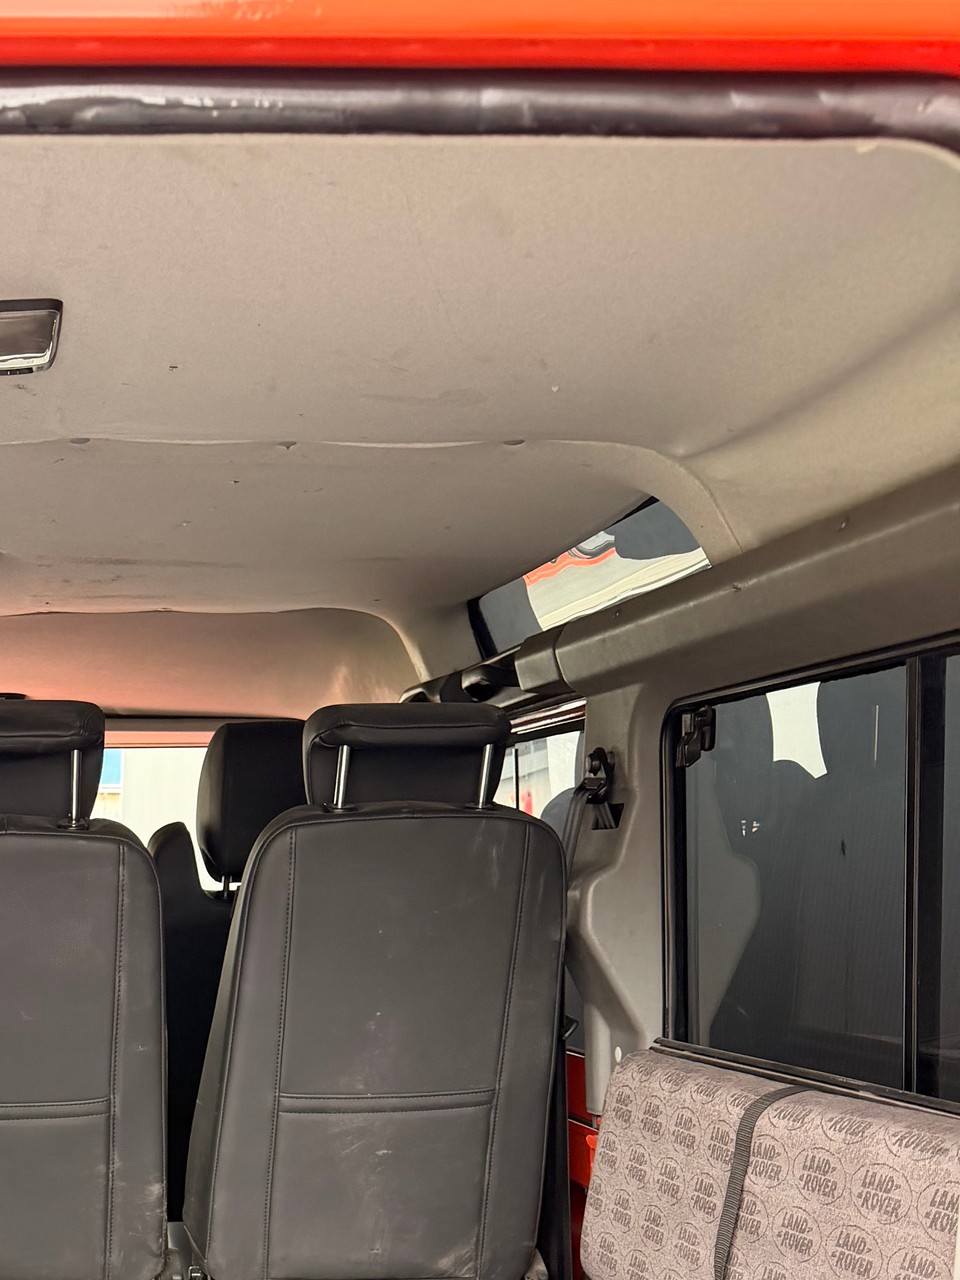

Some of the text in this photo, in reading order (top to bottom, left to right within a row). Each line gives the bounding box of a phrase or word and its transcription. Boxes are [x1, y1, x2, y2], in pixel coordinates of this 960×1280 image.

[644, 1100, 660, 1118] LAND
[675, 1112, 693, 1130] LAND
[674, 1132, 697, 1149] ROVER
[711, 1126, 729, 1146] LAND
[629, 1149, 645, 1166] LAND
[752, 1141, 775, 1160] LAND
[660, 1161, 677, 1180] LAND
[751, 1161, 782, 1181] ROVER
[802, 1154, 831, 1177] LAND
[658, 1182, 681, 1199] ROVER
[695, 1178, 714, 1197] LAND
[802, 1176, 838, 1199] ROVER
[862, 1169, 894, 1195] LAND
[693, 1199, 717, 1217] ROVER
[741, 1197, 757, 1215] AND
[862, 1192, 902, 1219] ROVER
[929, 1188, 959, 1214] LAN
[645, 1209, 662, 1227] LAND
[740, 1215, 761, 1237] OVER
[781, 1212, 808, 1235] LAND
[929, 1210, 958, 1234] ROV
[643, 1228, 664, 1246] ROVER
[679, 1227, 698, 1246] LAND
[781, 1232, 813, 1256] ROVER
[835, 1231, 867, 1255] LAND
[629, 1253, 647, 1273] LAND
[677, 1247, 701, 1266] ROVER
[835, 1252, 873, 1279] ROVER
[899, 1252, 937, 1279] LAND
